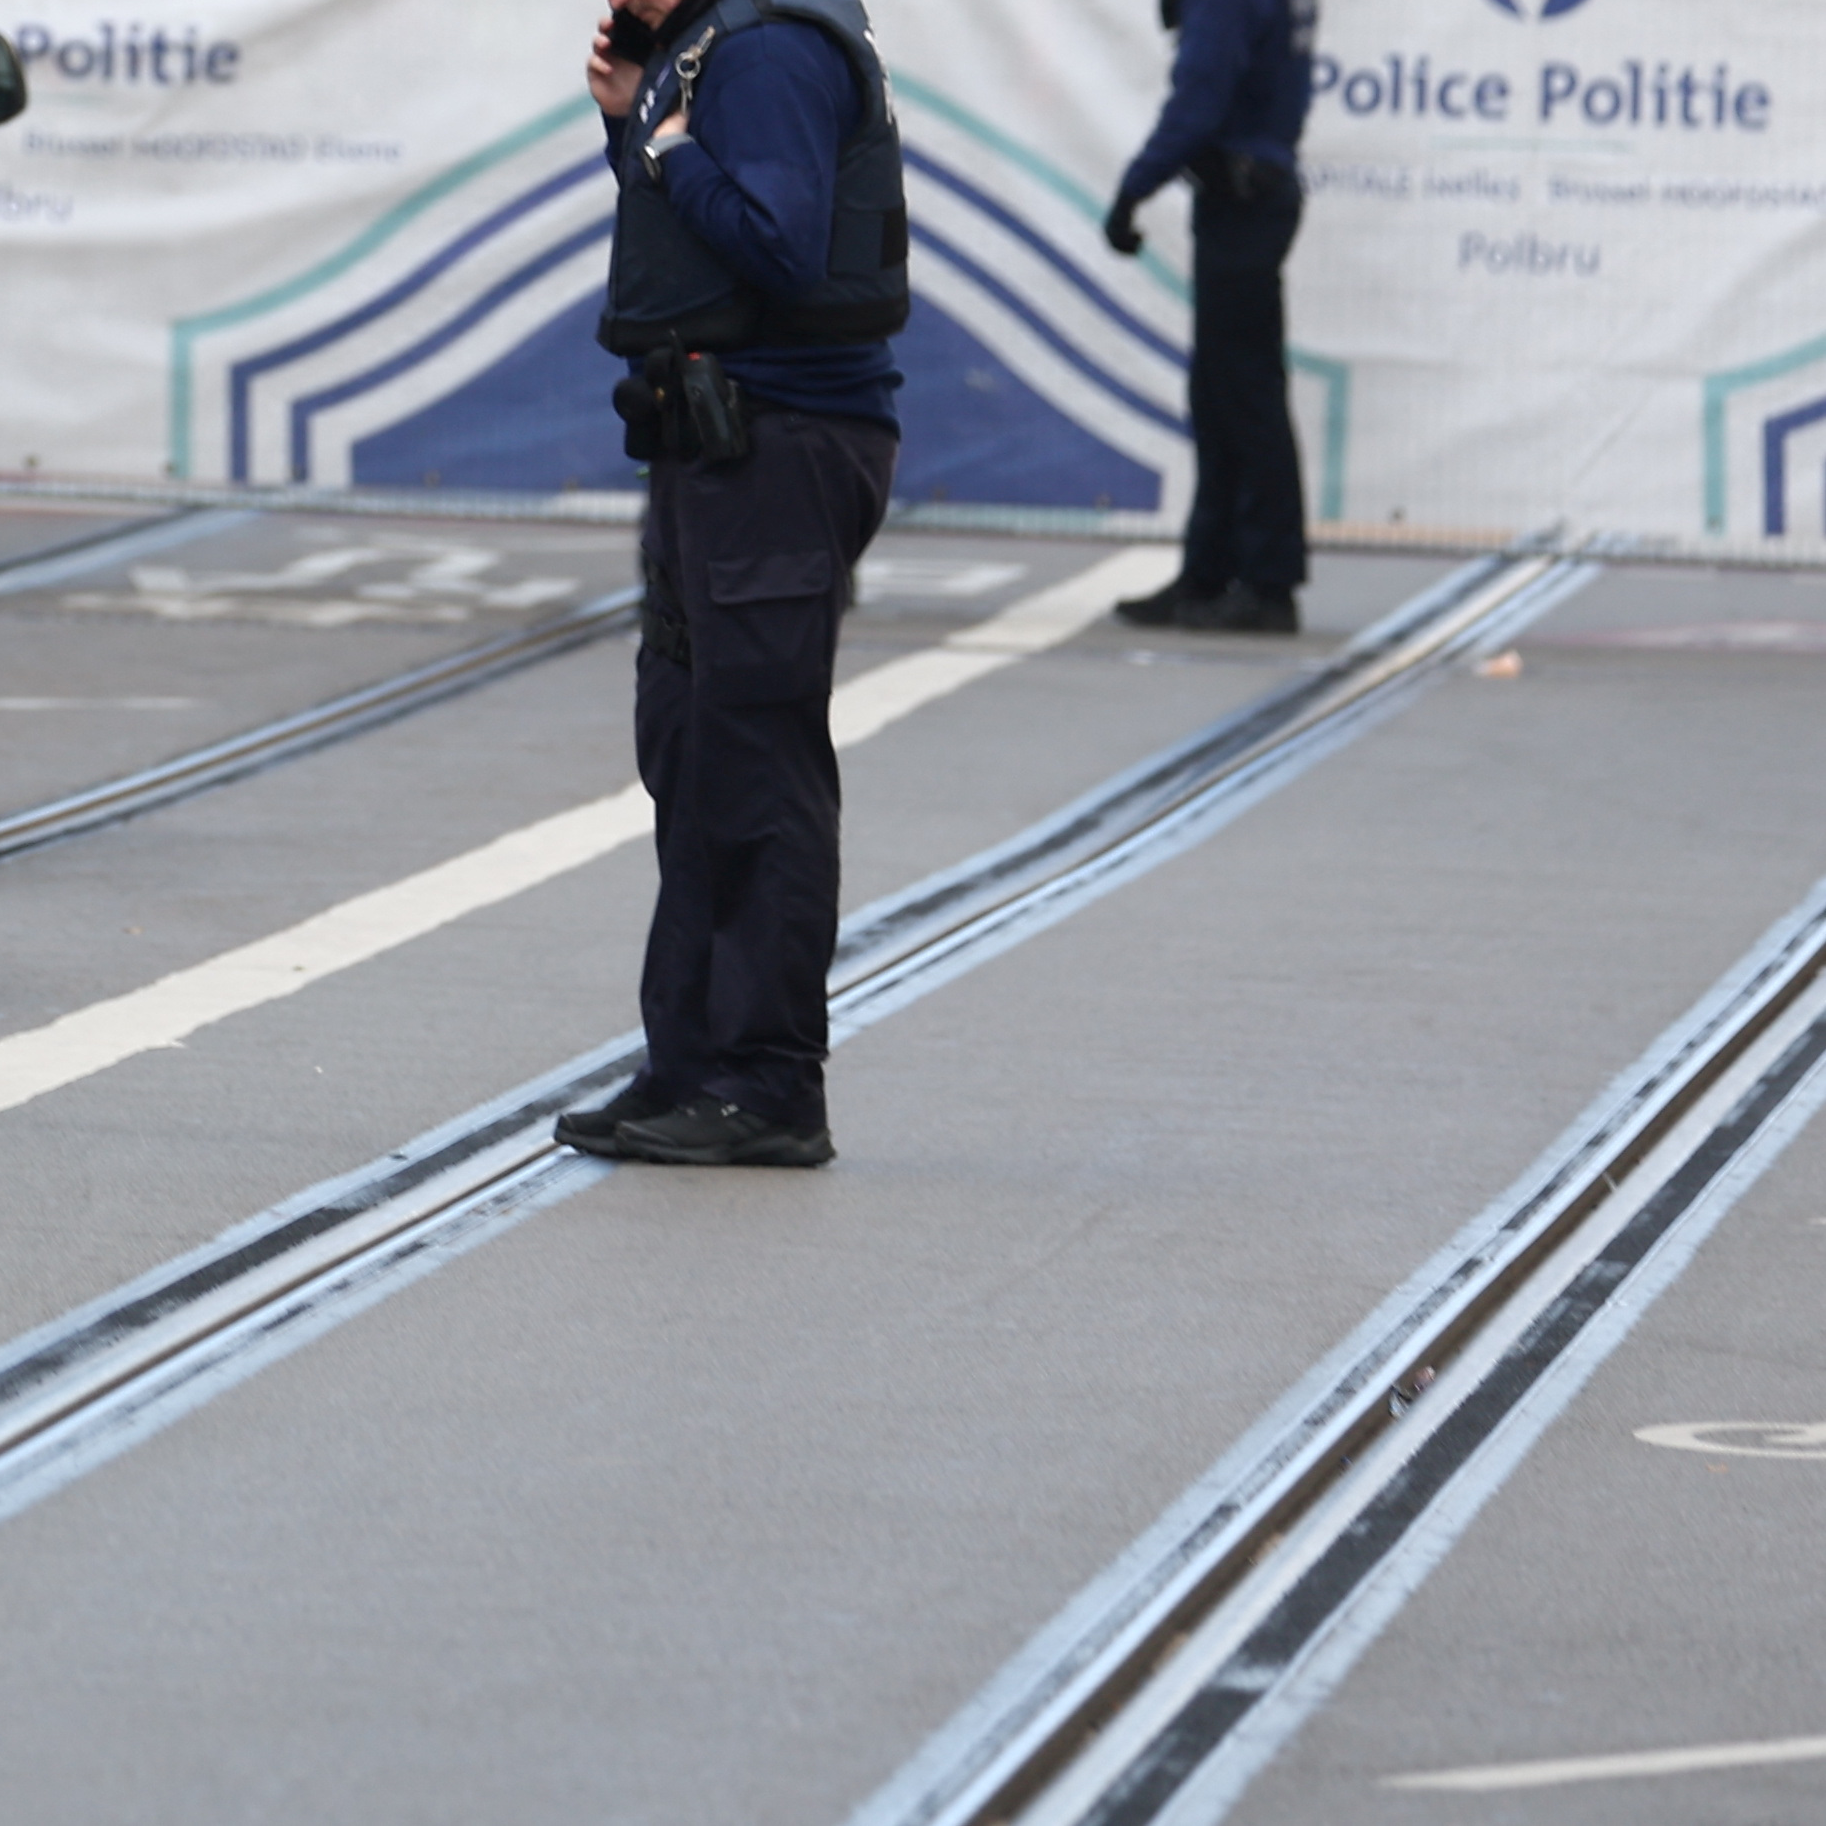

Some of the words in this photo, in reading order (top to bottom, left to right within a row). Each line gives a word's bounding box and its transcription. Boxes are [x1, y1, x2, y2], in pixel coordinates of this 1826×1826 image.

[16, 20, 240, 87] Politie
[1307, 53, 1510, 119] Police
[1537, 58, 1772, 131] Politie
[1458, 229, 1602, 276] Polbru
